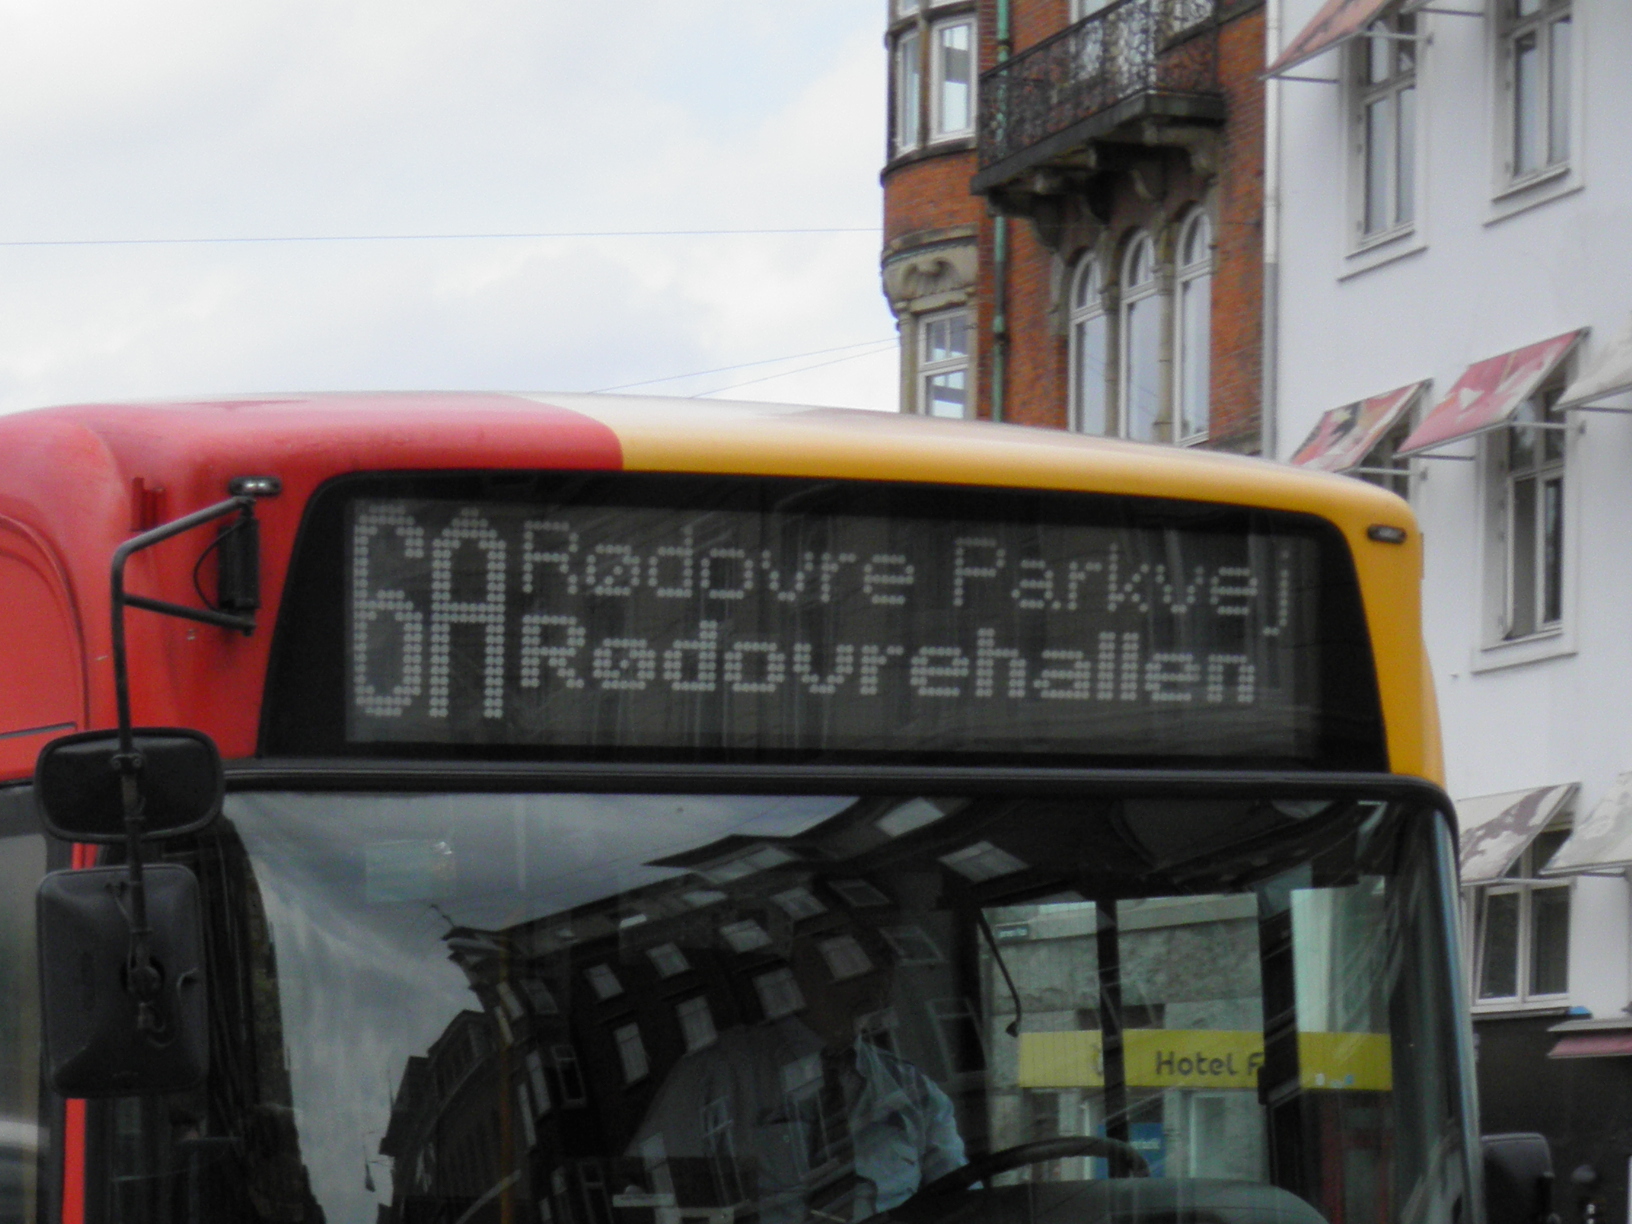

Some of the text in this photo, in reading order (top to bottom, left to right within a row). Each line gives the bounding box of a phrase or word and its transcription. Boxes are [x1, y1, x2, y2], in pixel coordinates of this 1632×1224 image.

[353, 504, 507, 718] 6A
[522, 520, 1291, 636] Rødovre Parkvej
[521, 614, 1256, 703] Rødovrehallen
[1154, 1050, 1238, 1077] Hotel
